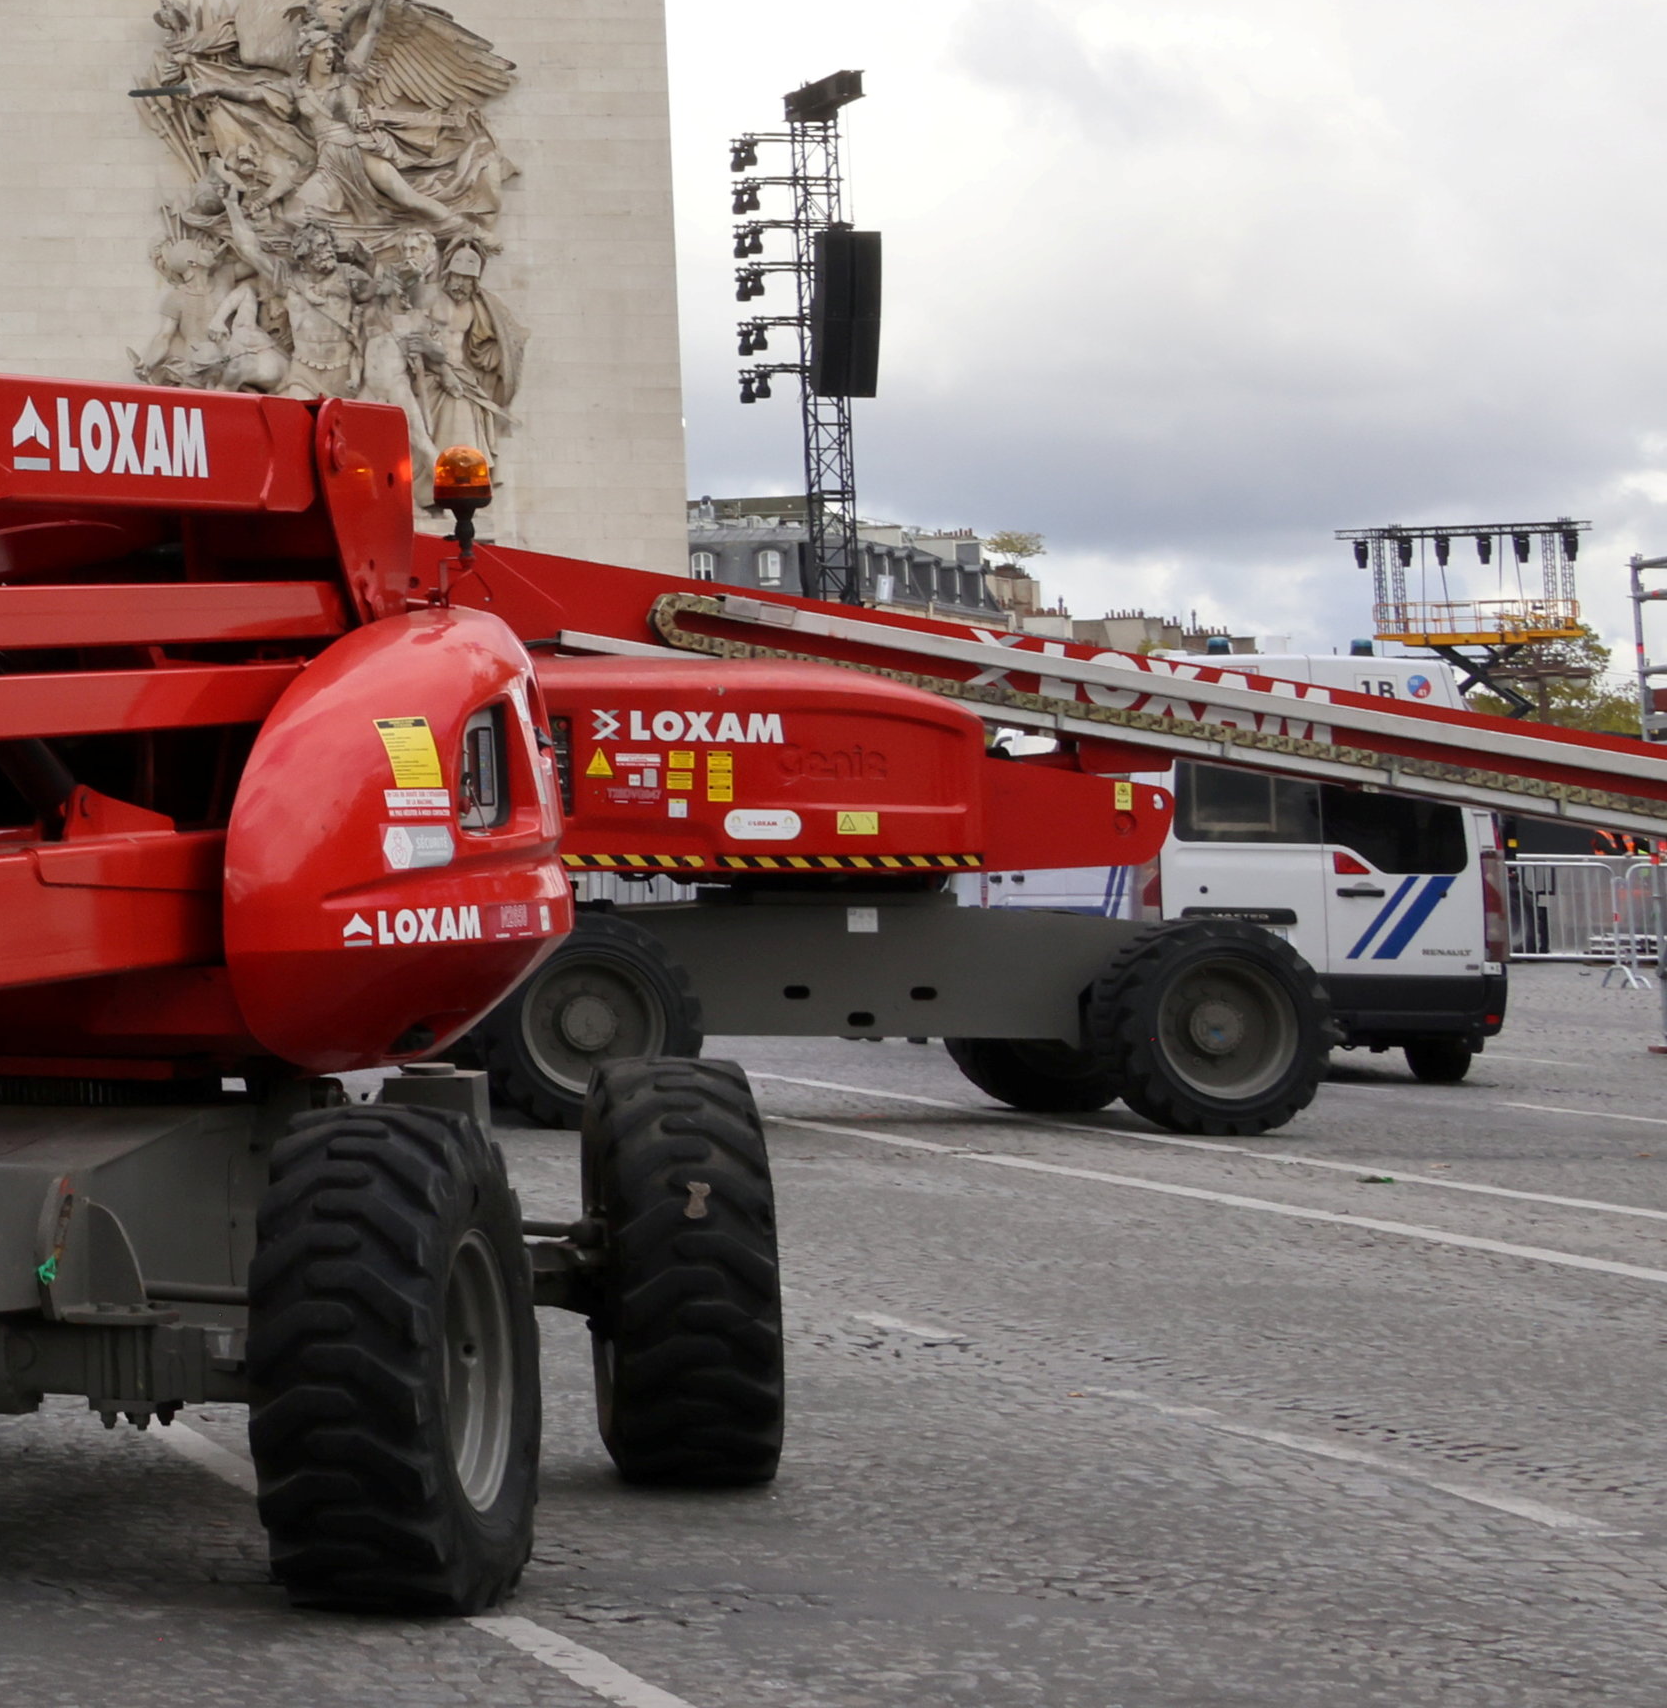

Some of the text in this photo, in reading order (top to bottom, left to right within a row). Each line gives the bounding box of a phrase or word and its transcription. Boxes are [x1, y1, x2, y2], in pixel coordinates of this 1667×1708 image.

[56, 396, 209, 478] LOXAM
[630, 710, 785, 743] LOXAM
[377, 905, 482, 945] LOXAM
[1422, 948, 1472, 957] RENAULT
